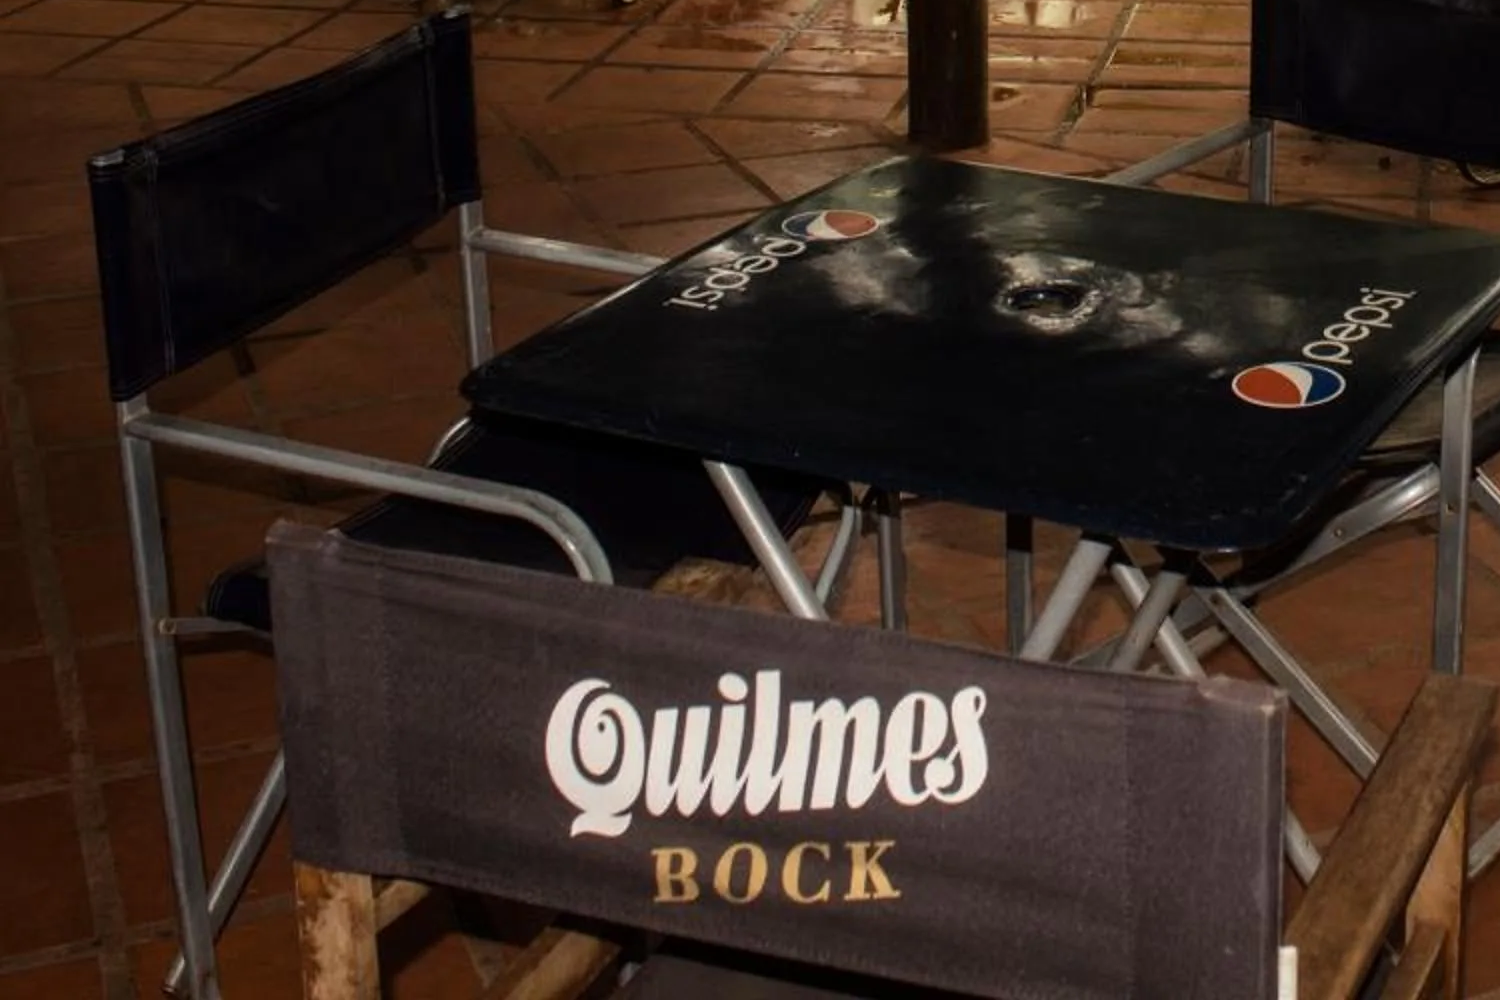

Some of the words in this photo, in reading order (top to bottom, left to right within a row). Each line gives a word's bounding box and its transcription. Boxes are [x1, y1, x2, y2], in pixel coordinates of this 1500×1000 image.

[661, 233, 807, 312] pepsi
[1301, 286, 1419, 366] pepsi
[544, 669, 989, 839] Quilmes
[650, 839, 903, 905] BOCK
